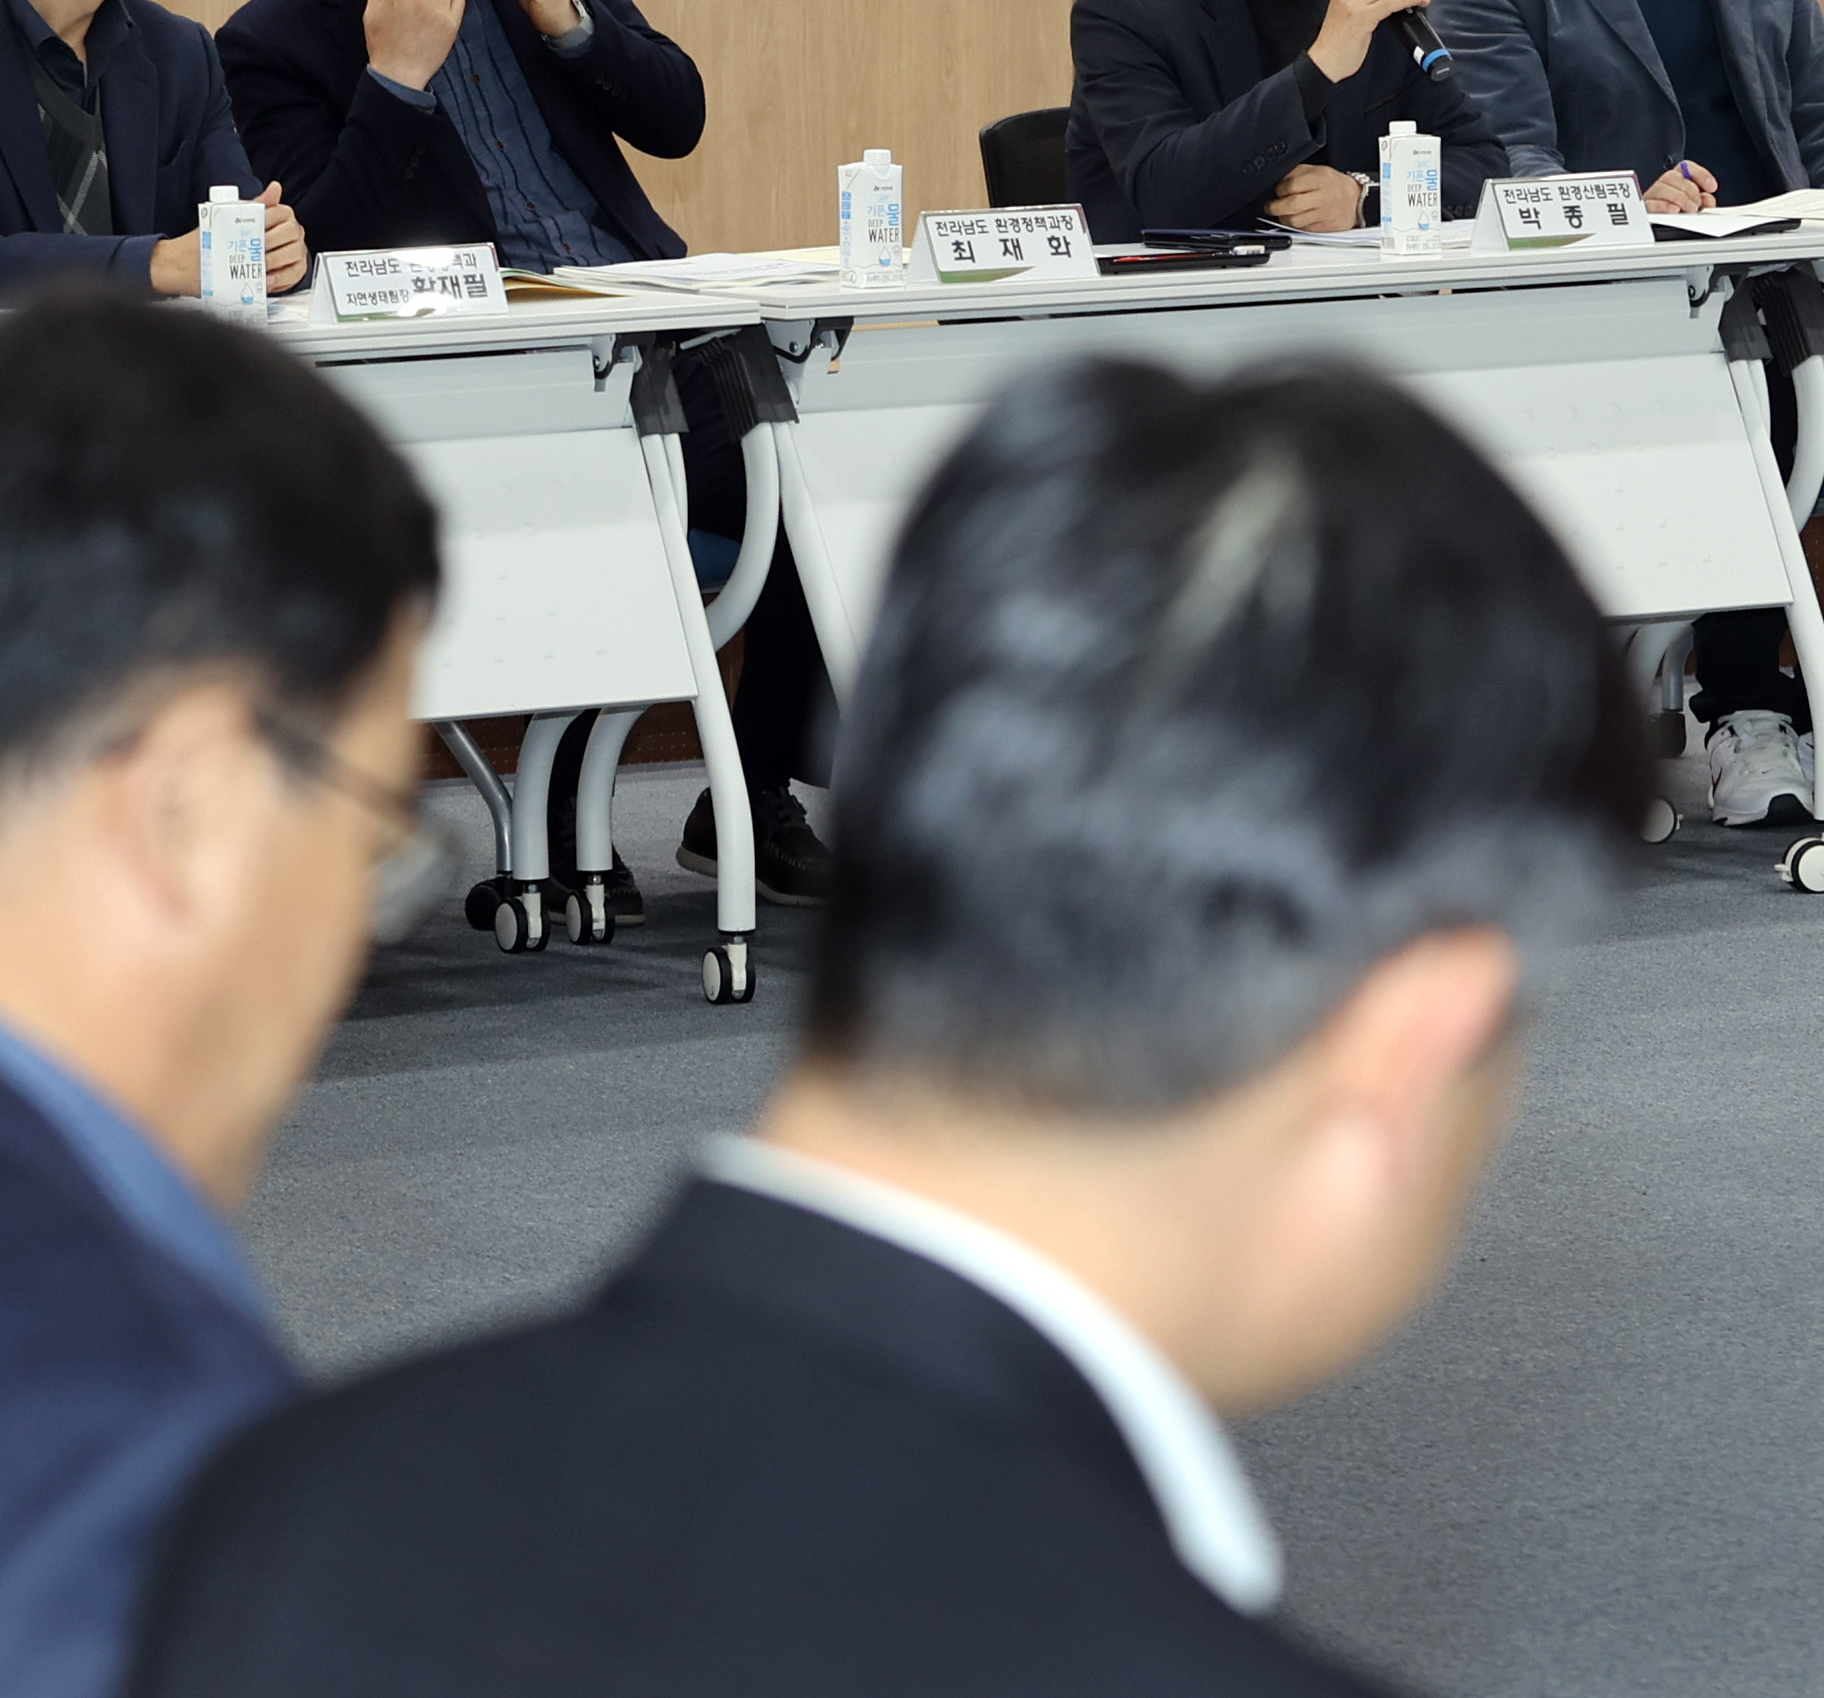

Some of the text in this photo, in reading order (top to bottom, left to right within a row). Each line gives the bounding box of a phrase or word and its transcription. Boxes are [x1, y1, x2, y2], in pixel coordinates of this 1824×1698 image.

[1407, 192, 1438, 208] WATER
[1503, 182, 1631, 205] 전라남도 환경산림국장
[935, 215, 1074, 237] 전라남도 환경정책과장
[1518, 207, 1542, 230] 박
[1606, 202, 1630, 226] 필
[868, 228, 900, 243] WATER
[951, 235, 1072, 263] 최 재 화
[229, 263, 263, 280] WATER
[344, 258, 402, 278] 전라남도
[346, 288, 410, 307] 자연생태팀장
